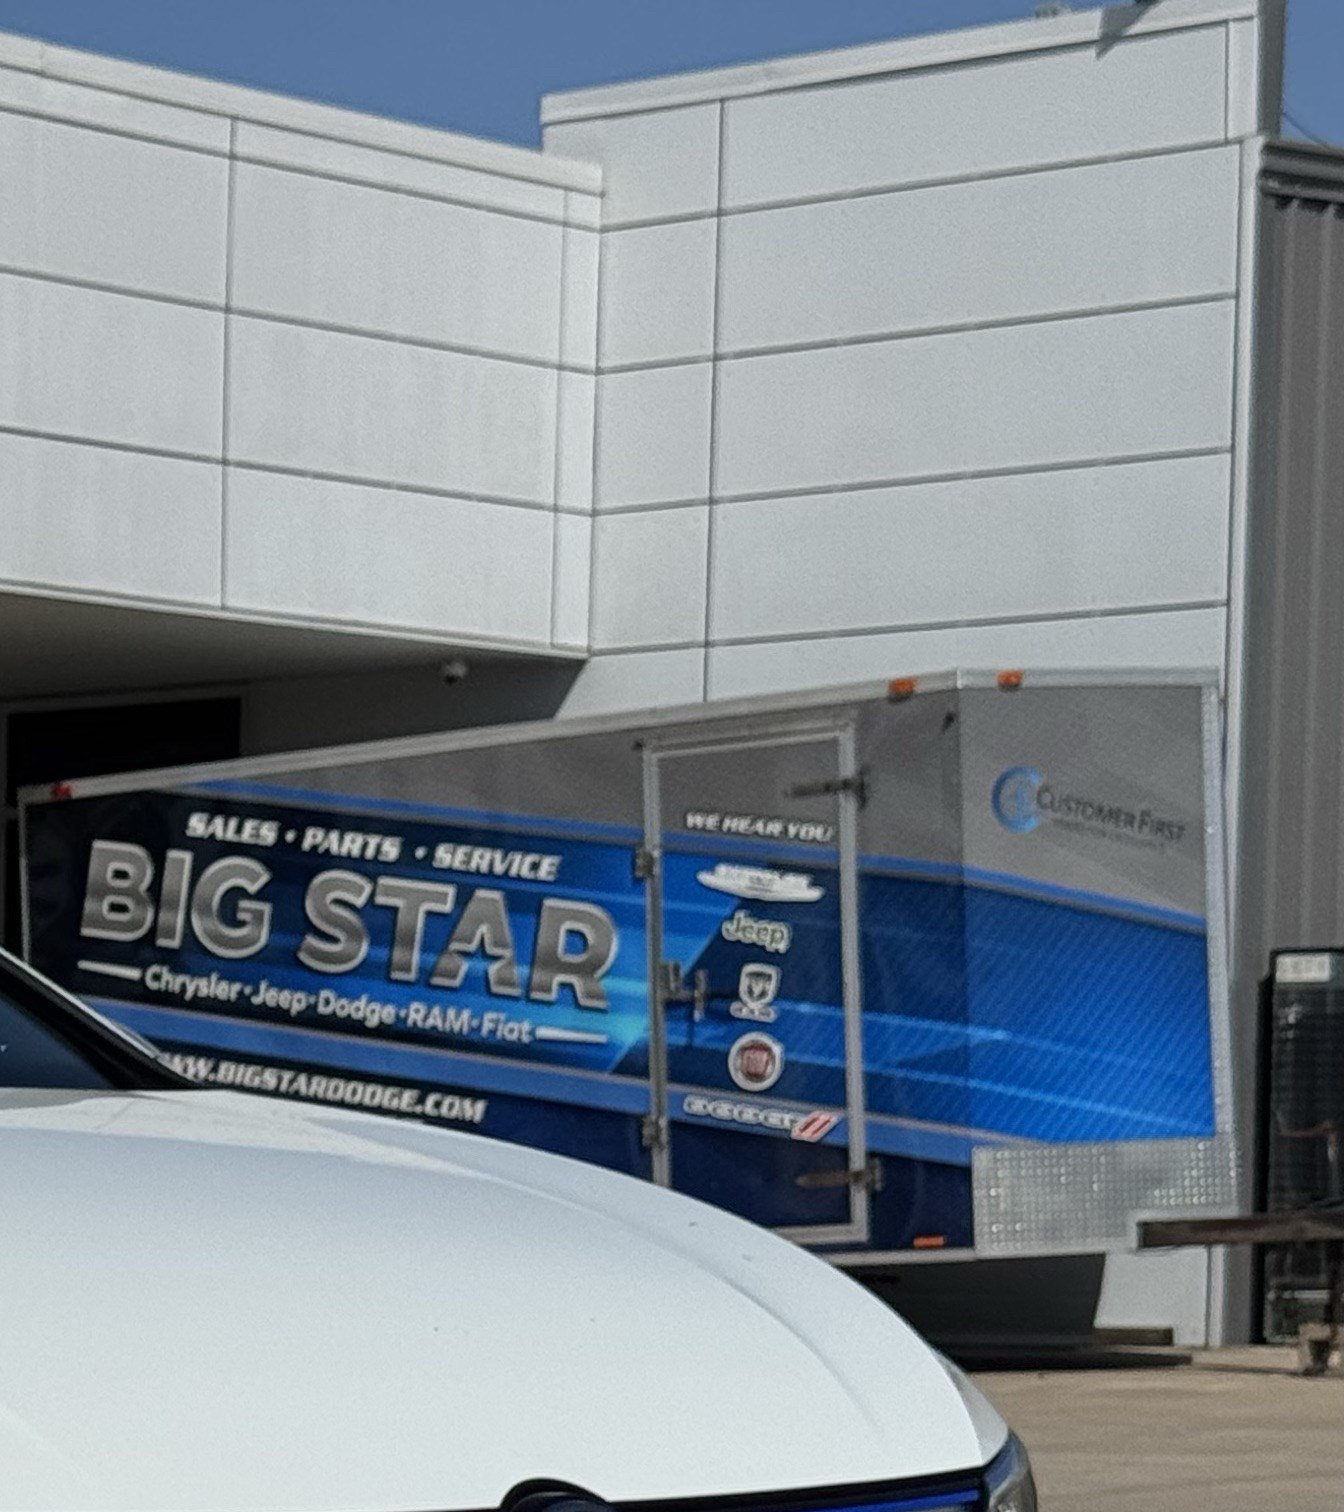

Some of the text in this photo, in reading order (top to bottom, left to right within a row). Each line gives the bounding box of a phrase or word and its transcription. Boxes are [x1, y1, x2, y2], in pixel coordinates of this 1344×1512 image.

[185, 811, 562, 882] SALES PARTS SERVICE
[686, 811, 833, 842] WE HEAR YOU
[79, 839, 619, 1009] BIG STAR
[724, 914, 785, 945] Jeep
[145, 963, 533, 1043] Chrysler Jeep Dodge RAM Fiat
